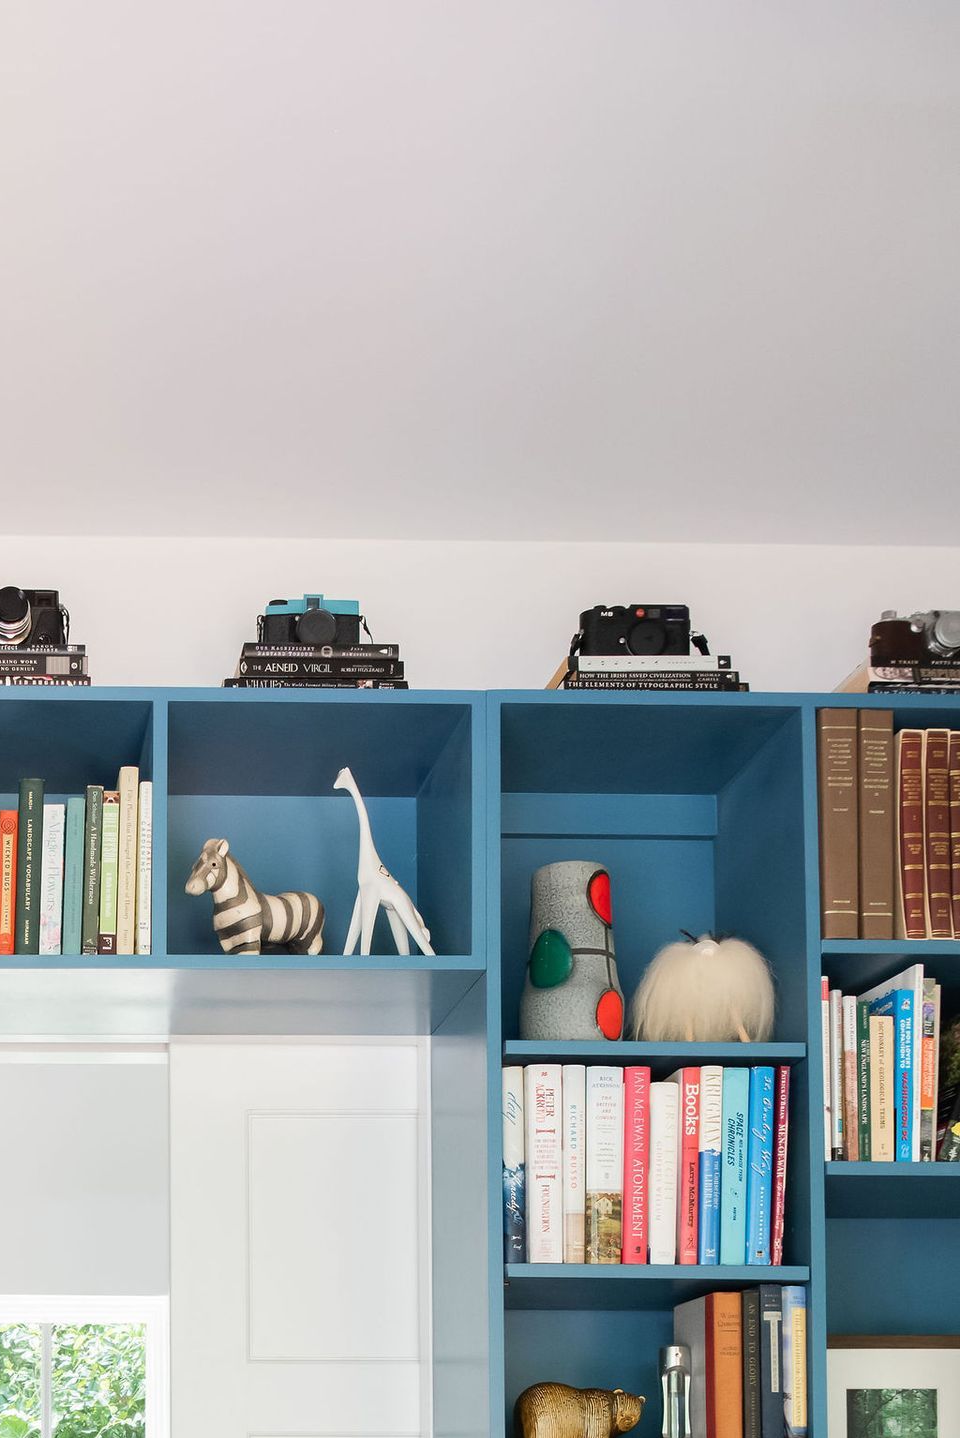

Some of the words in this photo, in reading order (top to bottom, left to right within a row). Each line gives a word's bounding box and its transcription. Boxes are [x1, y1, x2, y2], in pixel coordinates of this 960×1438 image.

[635, 1072, 644, 1094] IAN
[686, 1083, 699, 1135] Books
[631, 1159, 643, 1239] ATONEMENT
[687, 1188, 695, 1228] McMurtry
